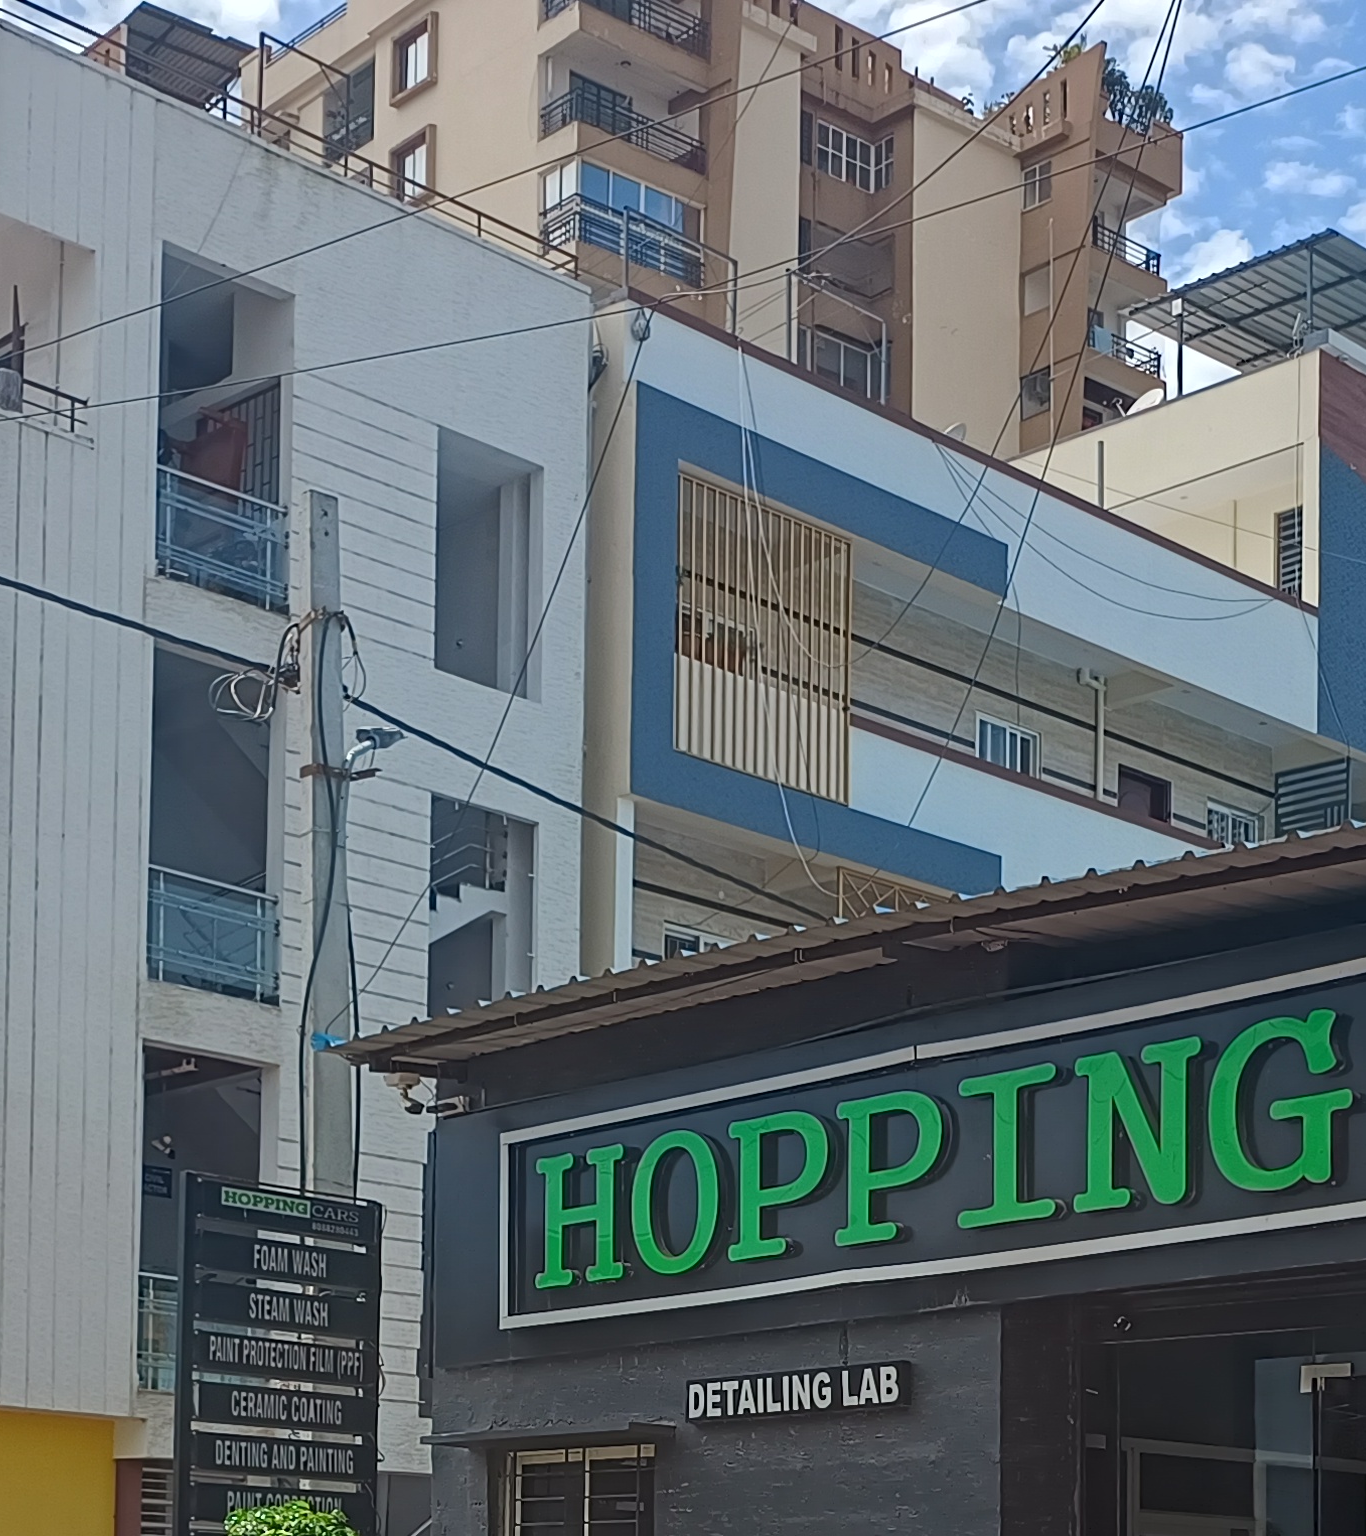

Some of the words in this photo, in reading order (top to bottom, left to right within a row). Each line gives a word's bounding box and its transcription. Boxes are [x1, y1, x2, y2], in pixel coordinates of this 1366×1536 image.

[534, 1008, 1353, 1289] HOPPING
[223, 1190, 309, 1215] HOPPING
[311, 1205, 359, 1223] CARS
[253, 1244, 288, 1273] FOAM
[291, 1249, 327, 1278] WASH
[249, 1293, 290, 1322] STEAM
[293, 1299, 328, 1327] WASH
[209, 1335, 240, 1363] PAINT
[242, 1339, 307, 1371] PROTECTION
[309, 1347, 334, 1373] FILM
[336, 1350, 364, 1382] (PPF)
[231, 1390, 288, 1420] CERAMIC
[291, 1396, 343, 1425] COATING
[688, 1371, 832, 1419] DETAILING
[841, 1365, 900, 1407] LAB
[215, 1439, 268, 1468] DENTING
[271, 1444, 296, 1470] AND
[299, 1446, 354, 1474] PAINTING
[227, 1490, 263, 1511] PAINT
